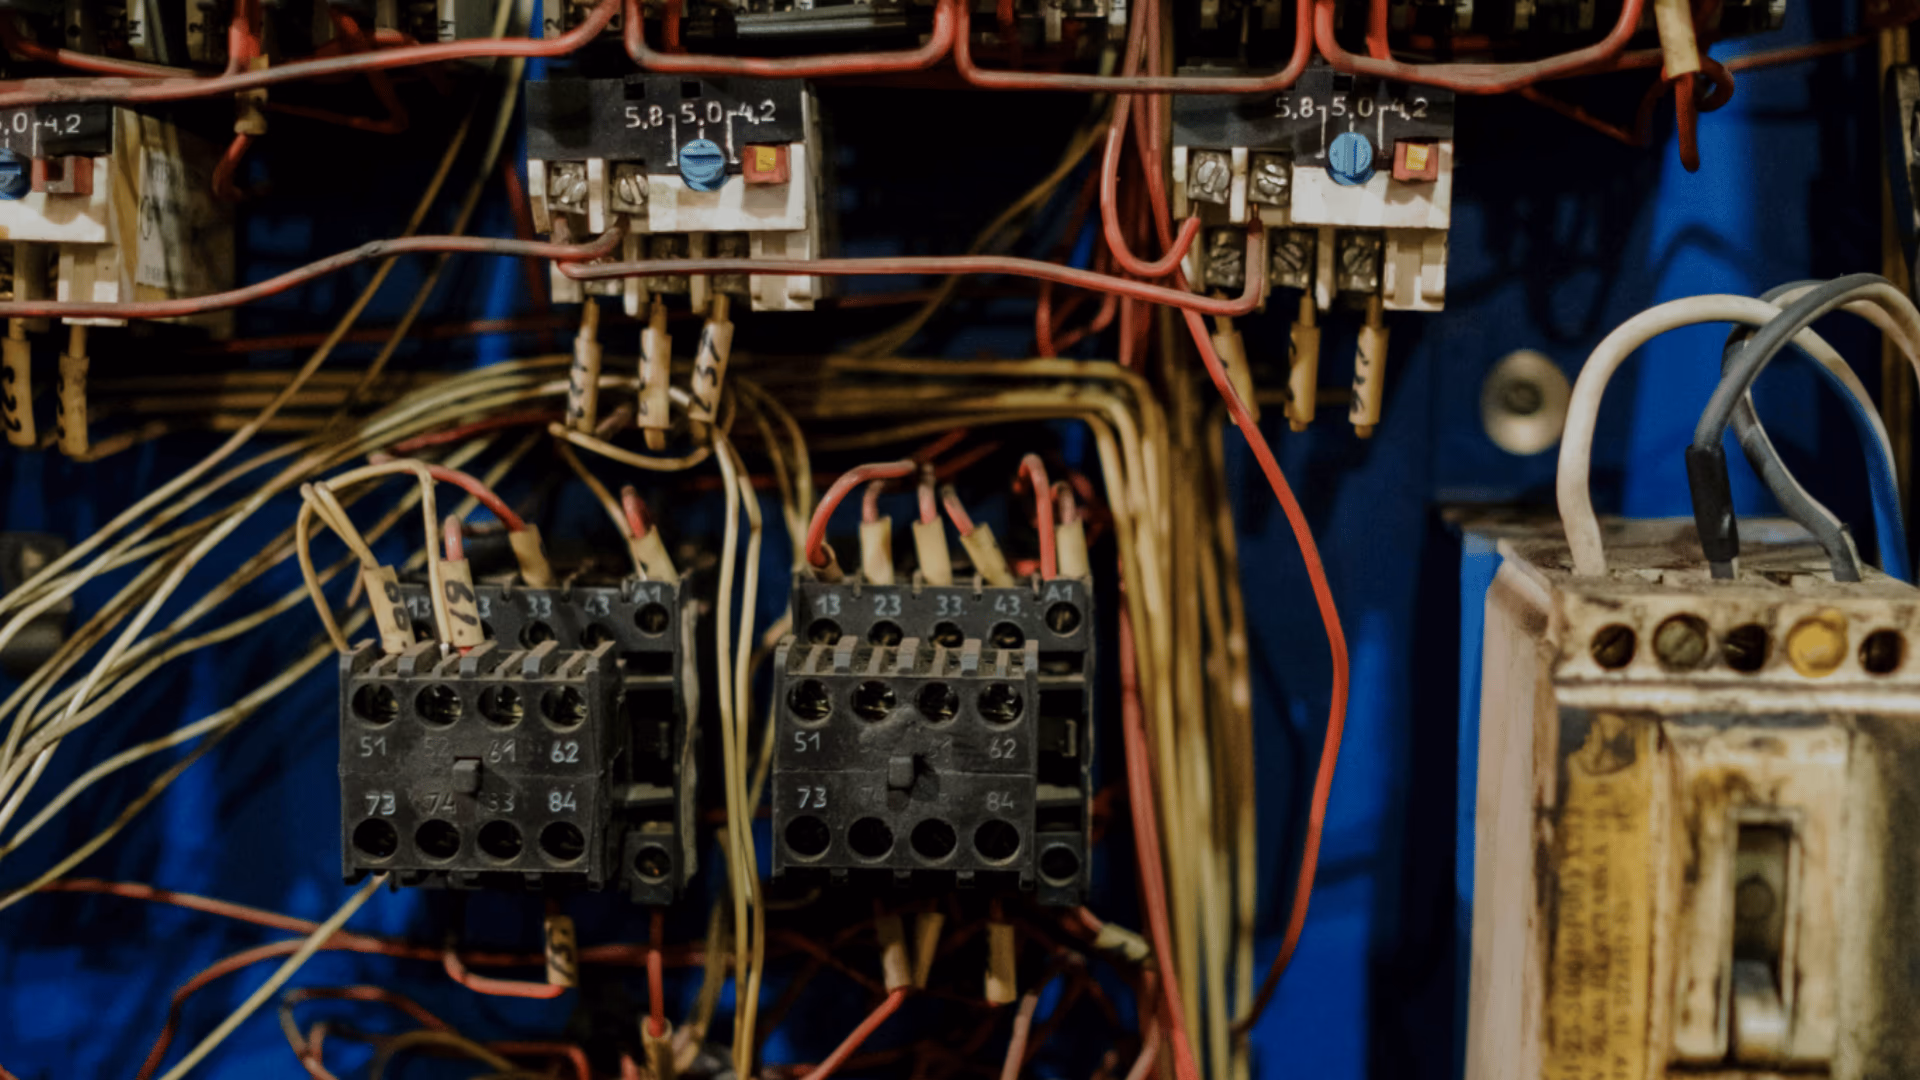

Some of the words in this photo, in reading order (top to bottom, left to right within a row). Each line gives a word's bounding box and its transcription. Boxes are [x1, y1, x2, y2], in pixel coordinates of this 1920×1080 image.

[625, 105, 663, 130] 5,8
[681, 101, 722, 126] 5,0
[738, 99, 776, 124] 4,2
[1275, 97, 1314, 120] 5,8
[1331, 97, 1374, 119] 5,0
[1389, 97, 1428, 120] 4,2
[43, 113, 81, 135] 4,2
[634, 586, 661, 603] A1
[1045, 584, 1073, 600] A1
[407, 595, 431, 618] 13
[479, 595, 492, 618] 3
[527, 595, 552, 618] 33
[585, 594, 610, 615] 43
[816, 593, 841, 615] 13
[874, 594, 901, 616] 23
[360, 736, 387, 757] 51
[488, 739, 517, 763] 61
[551, 740, 580, 763] 62
[794, 731, 821, 752] 51
[988, 737, 1017, 759] 62
[365, 792, 396, 816] 73
[549, 789, 577, 812] 84
[797, 787, 828, 809] 73
[985, 791, 1015, 812] 84
